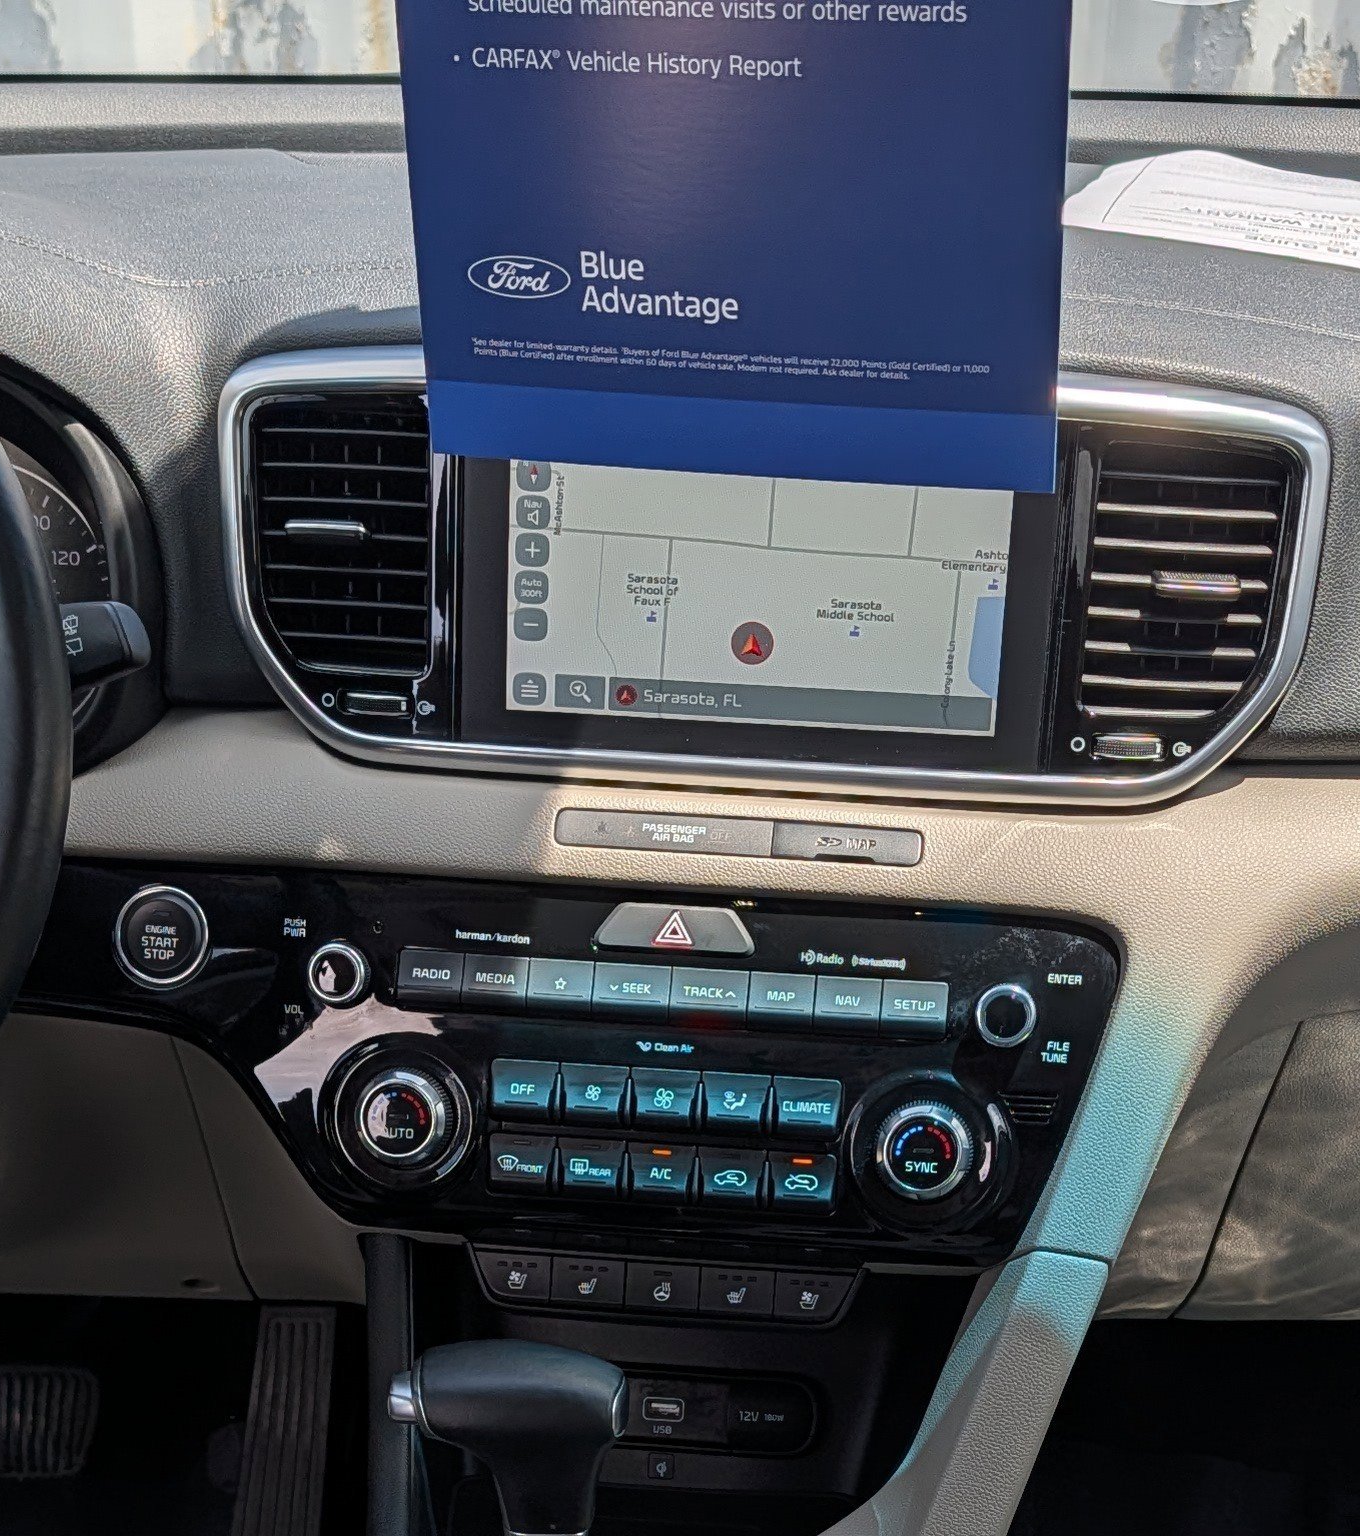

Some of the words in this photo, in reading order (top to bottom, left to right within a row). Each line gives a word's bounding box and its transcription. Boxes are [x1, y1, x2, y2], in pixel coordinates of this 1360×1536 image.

[580, 0, 714, 18] maintenance
[721, 0, 776, 19] visits
[783, 4, 804, 20] or
[812, 0, 871, 21] other
[878, 0, 967, 22] rewards
[566, 50, 640, 73] Vehicle
[647, 52, 722, 80] History
[729, 55, 803, 80] Report
[580, 250, 644, 281] Blue
[488, 260, 551, 292] Ford
[581, 285, 739, 325] Advantage
[473, 347, 498, 356] Points
[688, 361, 716, 370] vehicle
[822, 367, 837, 376] Ask
[838, 369, 864, 378] dealer
[661, 349, 679, 358] Ford
[681, 350, 699, 359] Blue
[750, 355, 782, 364] vehicles
[861, 360, 887, 369] Points
[523, 499, 543, 509] Nav
[52, 550, 80, 567] 120
[941, 560, 1007, 574] Elementary
[521, 578, 542, 588] Auto
[627, 573, 679, 586] Sarasota
[626, 584, 664, 596] School
[666, 586, 679, 597] of
[633, 596, 661, 607] Faux
[830, 598, 882, 611] Sarasota
[816, 609, 854, 621] Middle
[856, 610, 894, 623] School
[643, 689, 719, 708] Sarasota,
[723, 694, 742, 707] FL
[642, 822, 706, 836] PASSENGER
[651, 831, 672, 842] AIR
[673, 833, 695, 843] BAG
[845, 837, 877, 851] MAP
[284, 917, 306, 927] PUSH
[145, 925, 177, 935] ENGINE
[283, 927, 306, 937] PWR
[141, 936, 179, 948] START
[455, 929, 530, 945] harman/kardon
[144, 948, 175, 960] STOP
[816, 953, 844, 965] Radio
[412, 967, 451, 980] RADIO
[475, 972, 515, 985] MEDIA
[1047, 973, 1082, 985] ENTER
[622, 982, 651, 995] SEEK
[683, 985, 723, 999] TRACK
[767, 991, 796, 1002] MAP
[835, 995, 860, 1006] NAV
[284, 1003, 304, 1014] VOL
[894, 999, 936, 1011] SETUP
[654, 1043, 676, 1052] Clean
[677, 1043, 695, 1053] Air
[1046, 1041, 1070, 1052] FILE
[1041, 1052, 1067, 1064] TUNE
[510, 1083, 535, 1095] OFF
[782, 1100, 831, 1115] CLIMATE
[516, 1162, 544, 1174] FRONT
[588, 1167, 612, 1177] REAR
[649, 1166, 672, 1180] A/C
[905, 1160, 938, 1175] SYNC
[739, 1411, 759, 1422] 12V
[653, 1425, 673, 1435] USB
